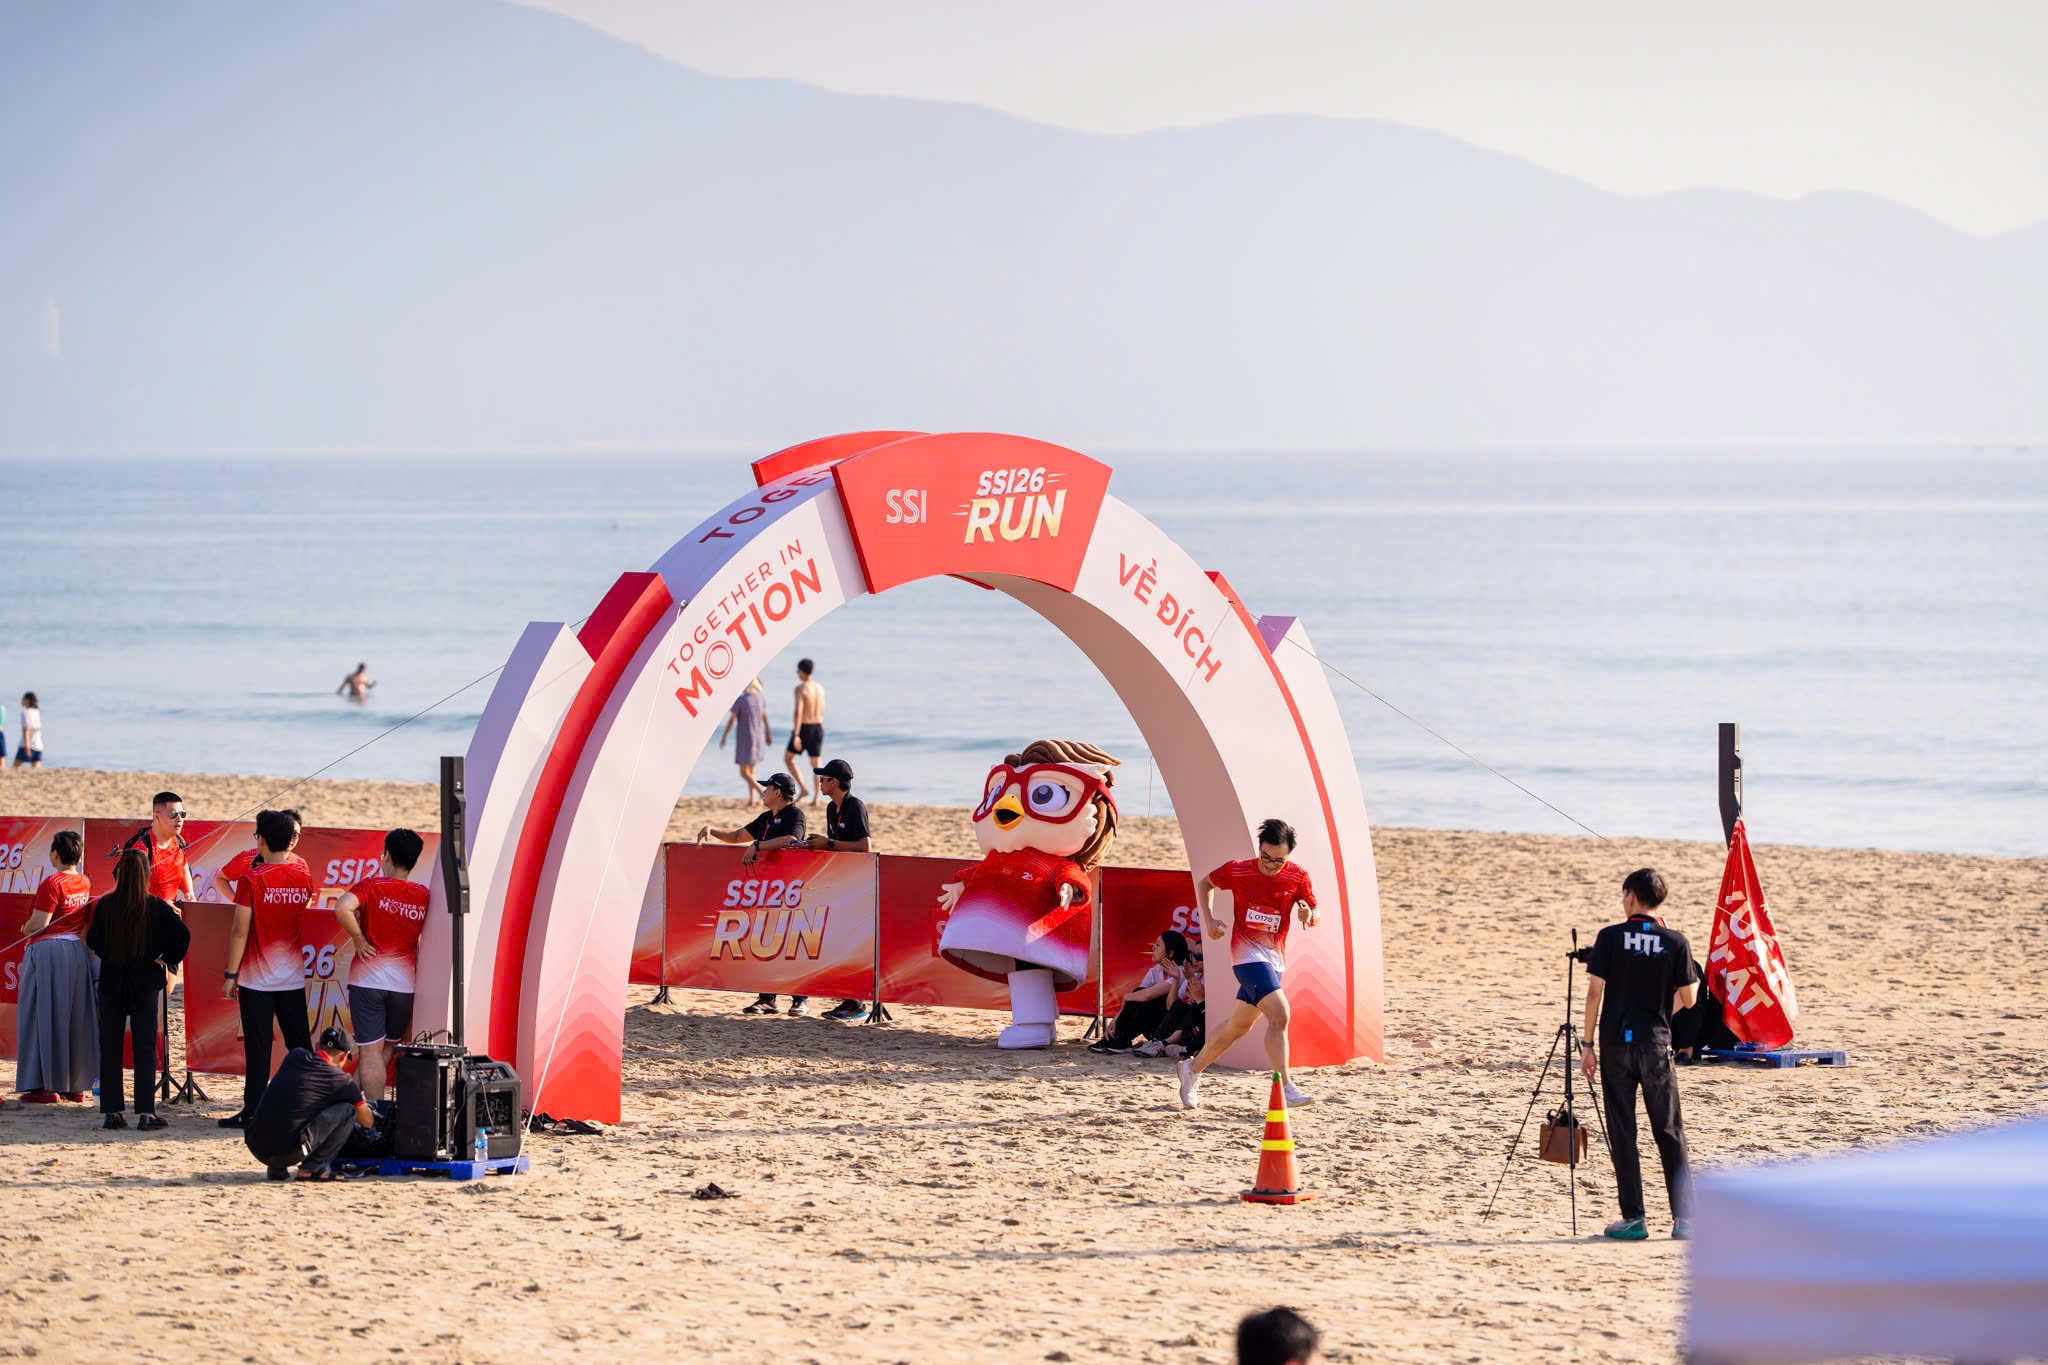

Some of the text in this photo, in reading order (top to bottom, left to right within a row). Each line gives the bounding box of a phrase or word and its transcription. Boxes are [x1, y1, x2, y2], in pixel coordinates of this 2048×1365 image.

[976, 467, 1047, 496] SSI26
[886, 489, 927, 524] SSI
[964, 488, 1067, 544] RUN
[667, 539, 803, 676] TOGETHER IN
[675, 558, 822, 719] MOTION
[1156, 592, 1222, 683] ĐÍCH
[324, 858, 384, 886] SSI2
[264, 892, 308, 904] MOTION
[379, 900, 426, 920] MOTION
[724, 880, 804, 908] SSI26
[710, 905, 829, 961] RUN
[1624, 931, 1665, 957] HTL
